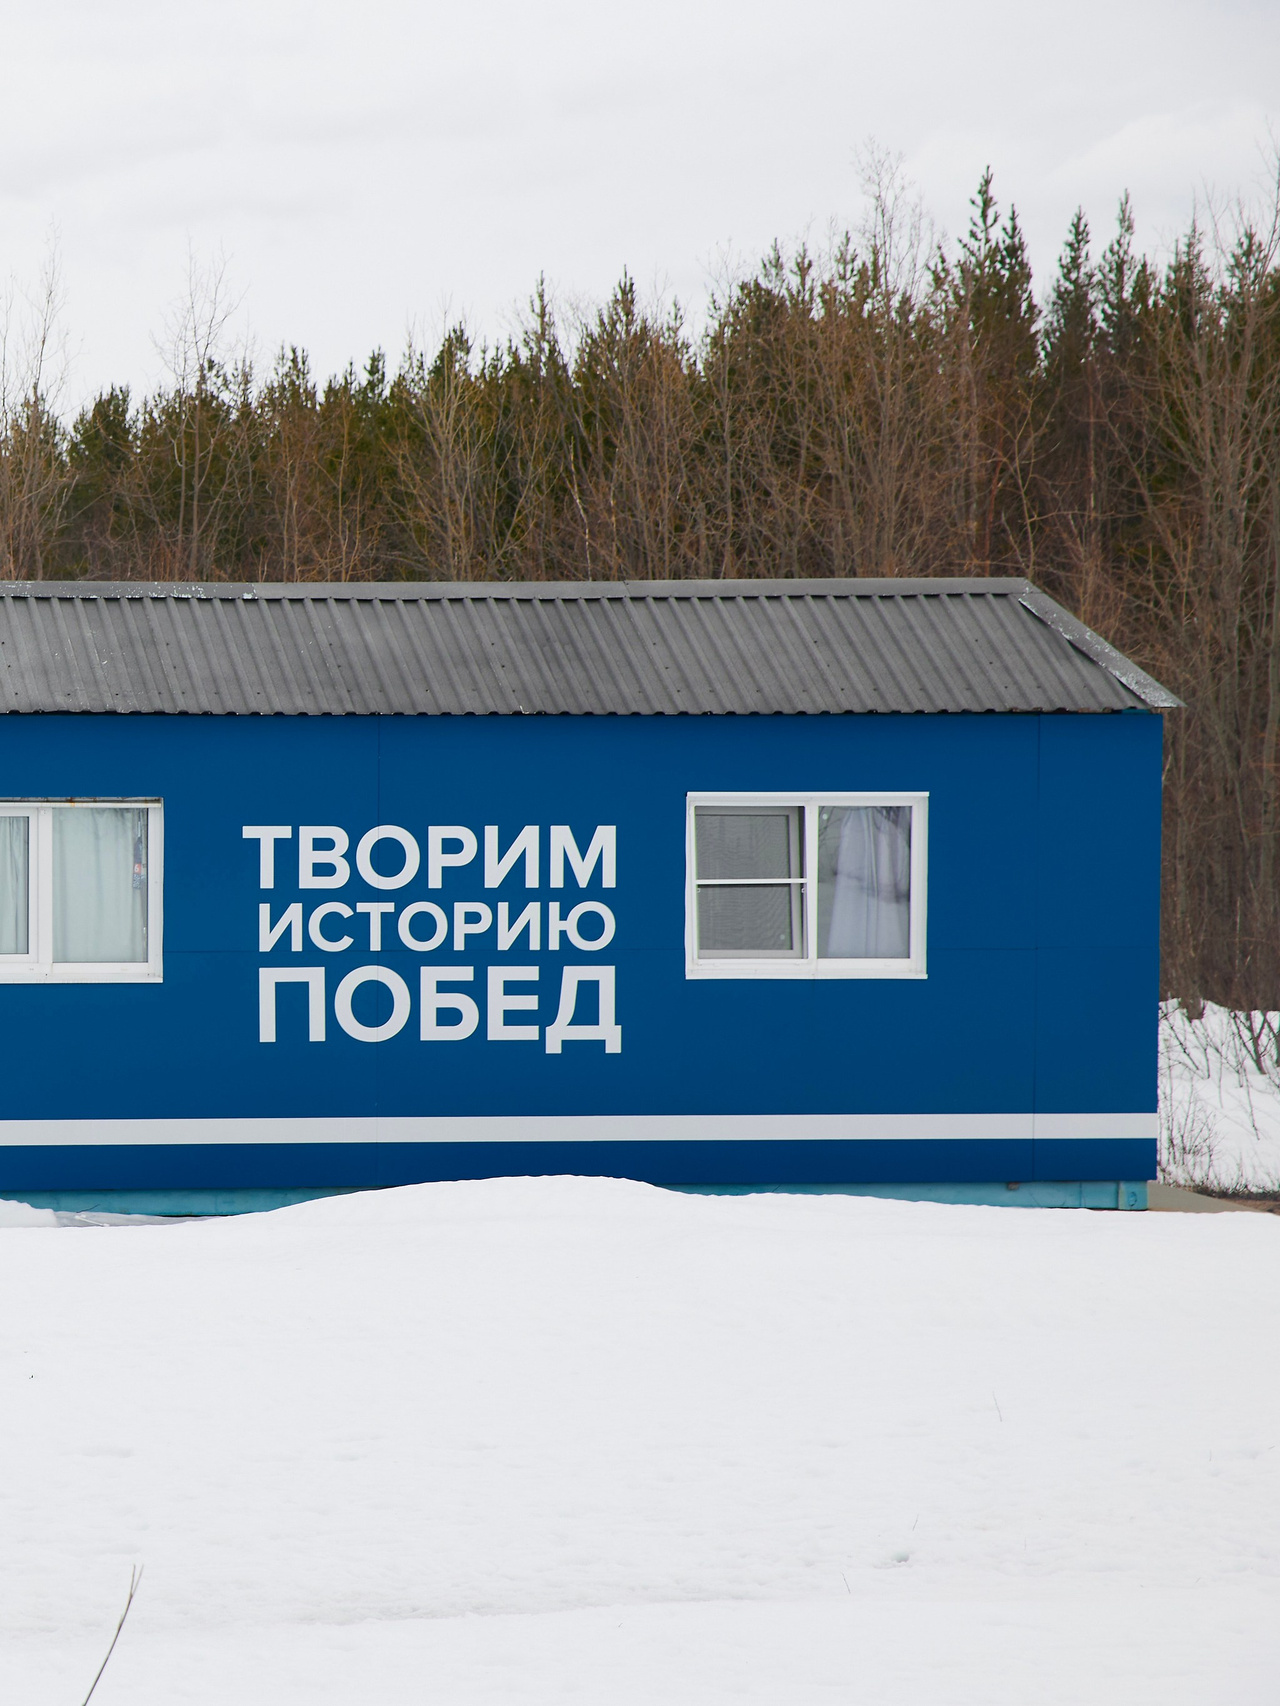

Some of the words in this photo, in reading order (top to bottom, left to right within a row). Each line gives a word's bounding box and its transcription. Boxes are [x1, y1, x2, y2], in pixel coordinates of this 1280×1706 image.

[242, 824, 617, 890] ТВОРИМ
[258, 900, 617, 953] ИСТОРИЮ
[258, 964, 622, 1054] ПОБЕД
